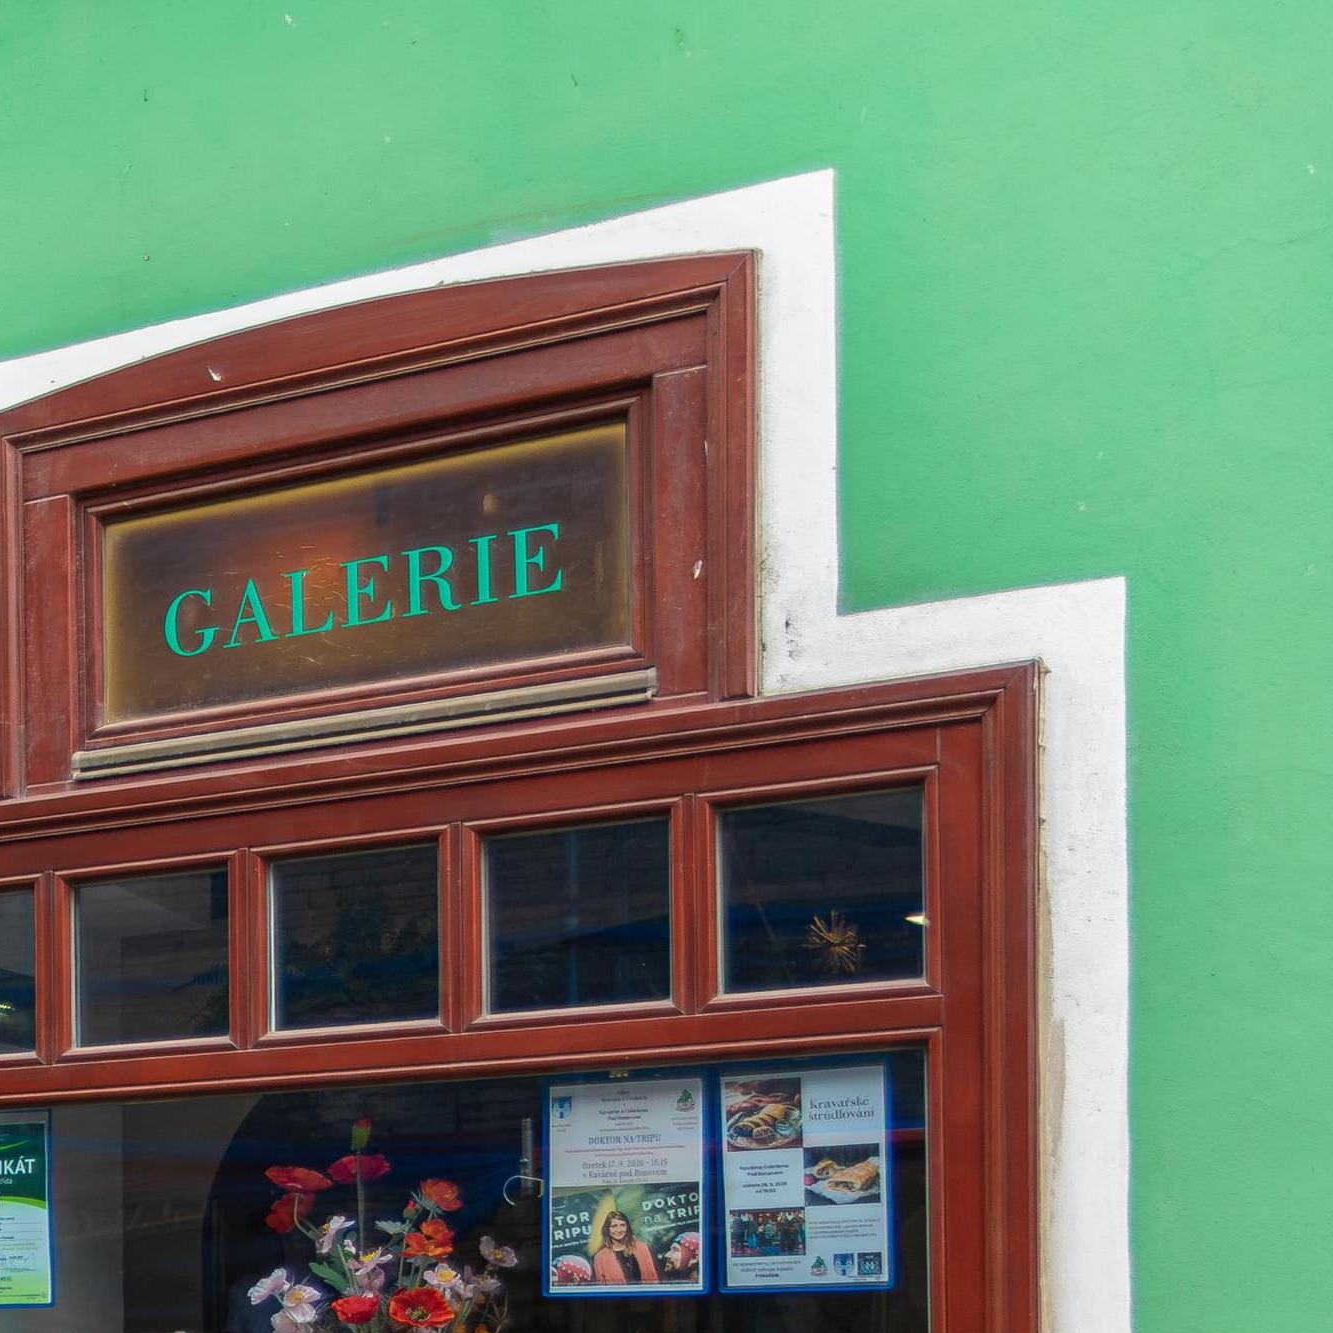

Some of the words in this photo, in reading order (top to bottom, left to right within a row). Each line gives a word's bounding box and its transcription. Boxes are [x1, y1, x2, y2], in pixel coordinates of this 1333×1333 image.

[163, 522, 563, 657] GALERIE
[588, 1135, 620, 1145] DOKTOR
[624, 1135, 634, 1144] NA
[636, 1133, 662, 1143] TRIPU
